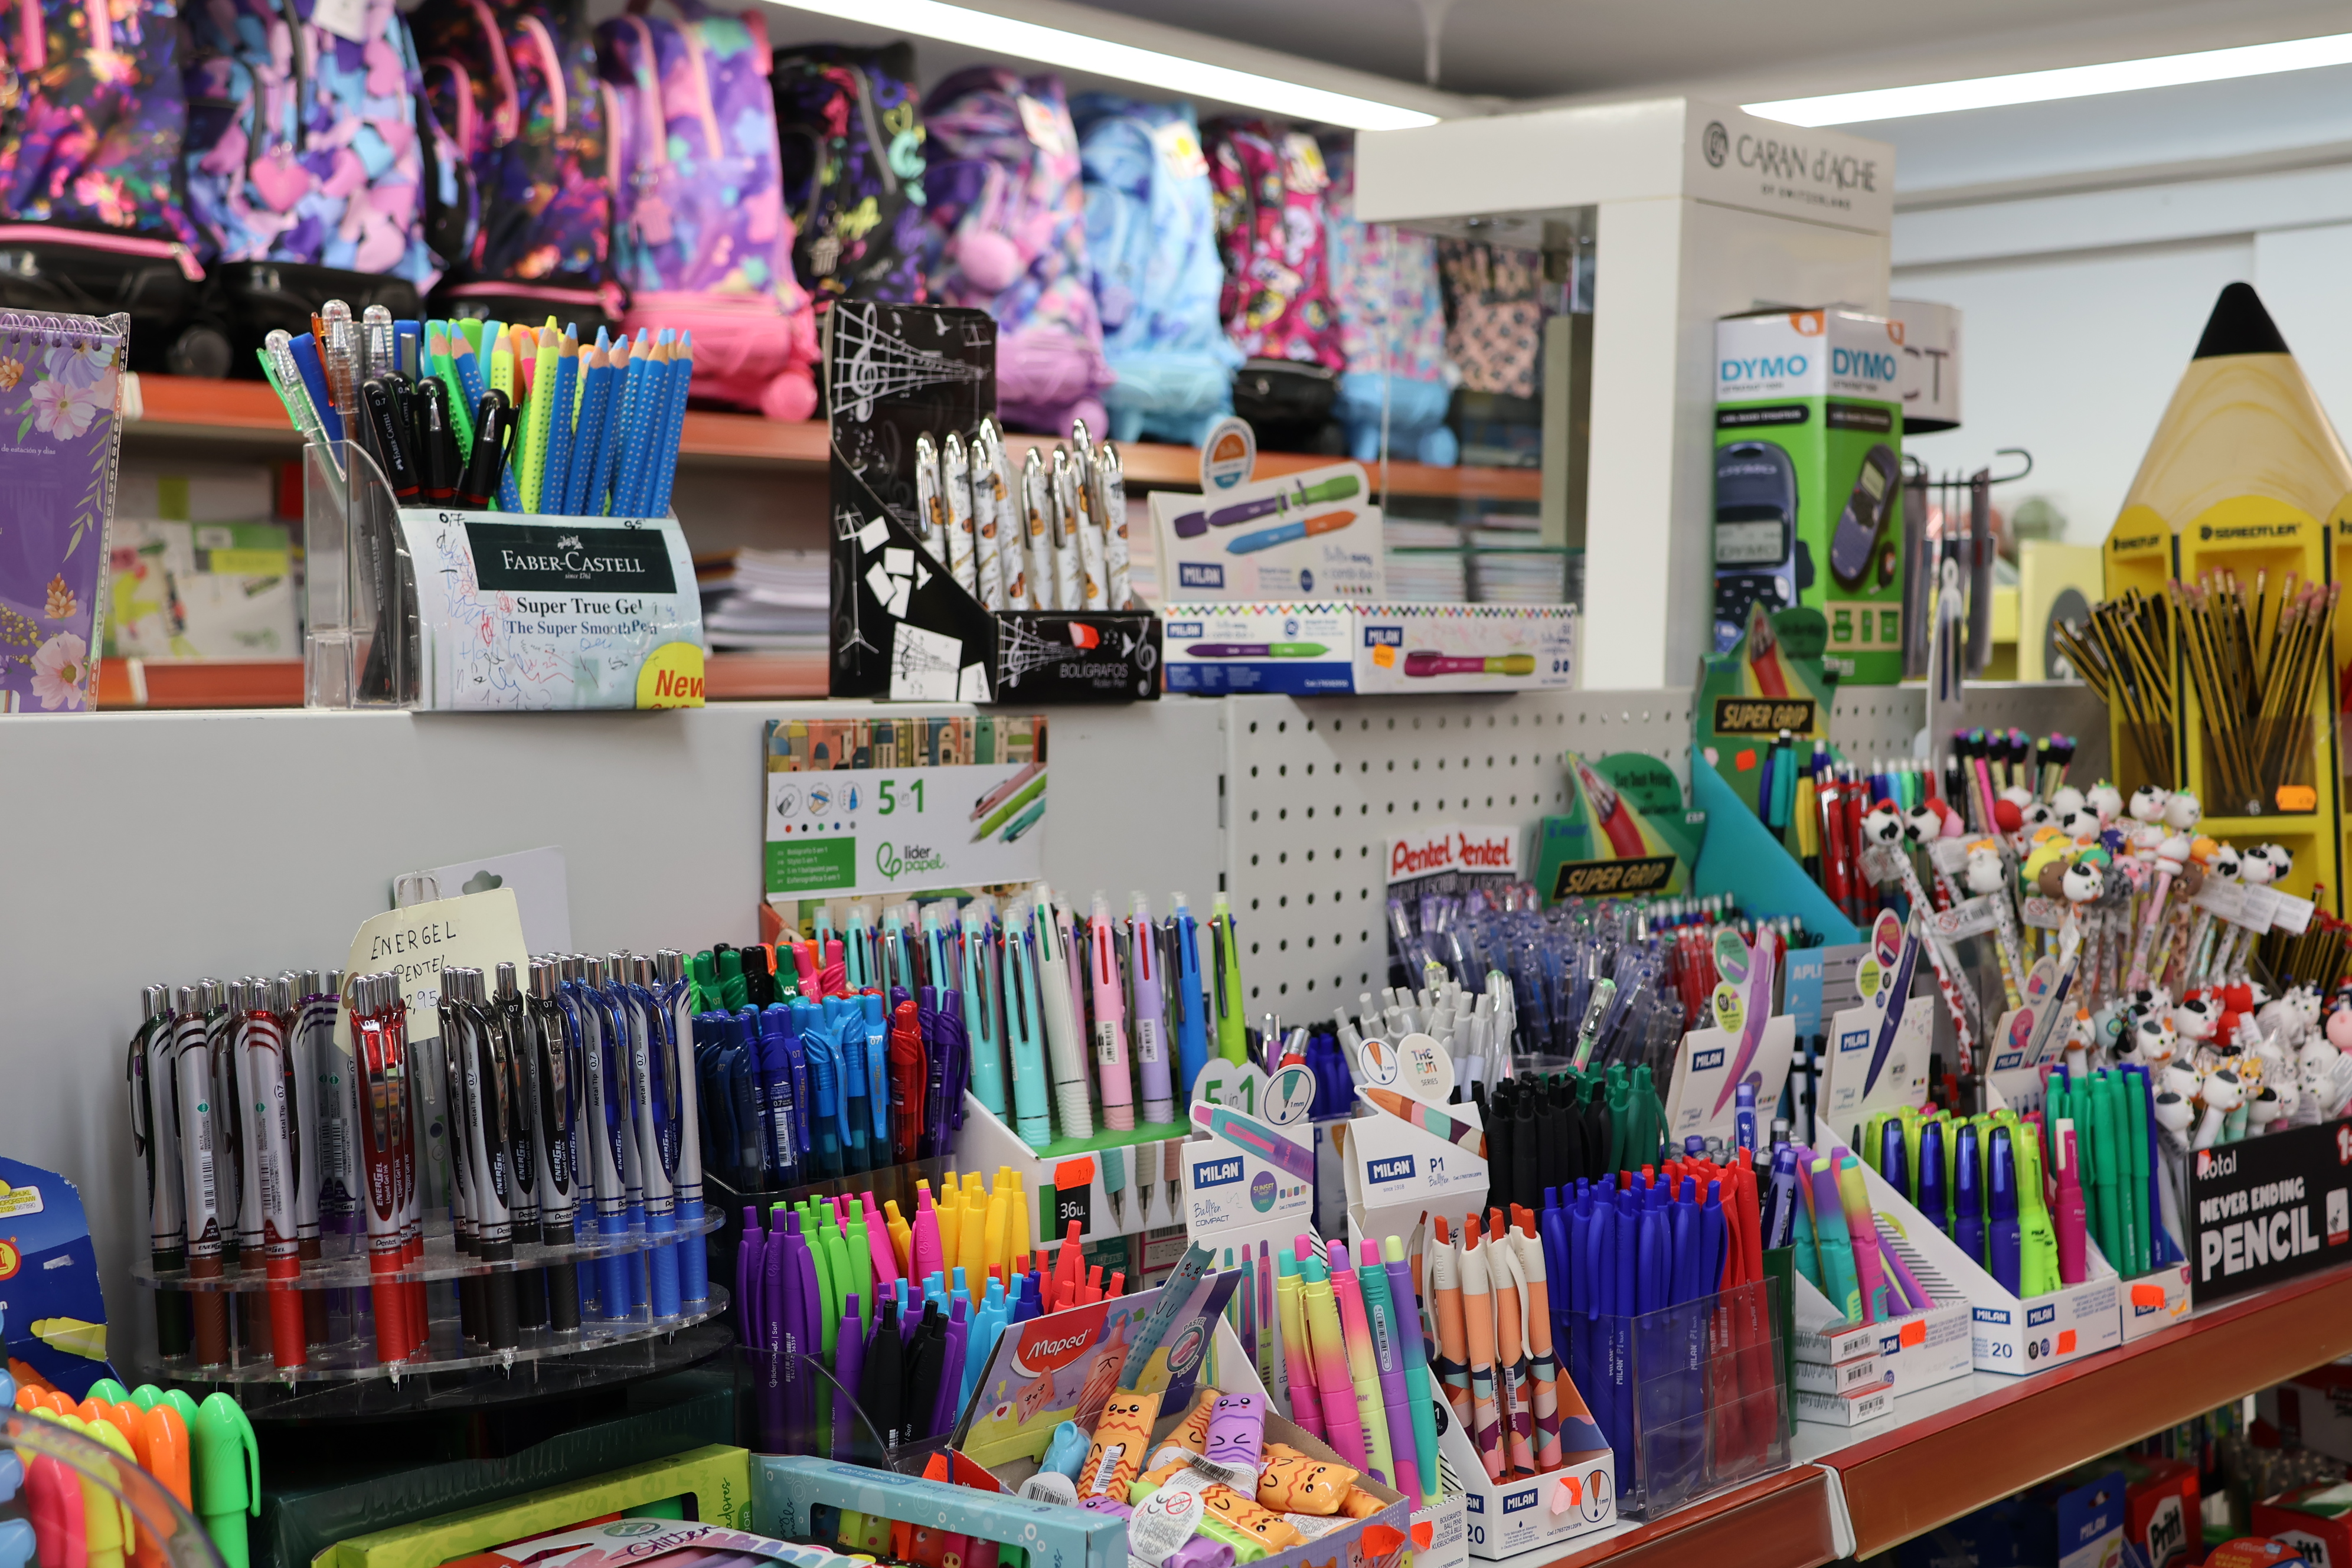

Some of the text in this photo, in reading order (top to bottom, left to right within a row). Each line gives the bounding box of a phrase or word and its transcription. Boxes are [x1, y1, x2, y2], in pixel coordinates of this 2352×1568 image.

[1737, 135, 1807, 179] CARAN
[1720, 355, 1808, 381] DYMO
[1832, 348, 1896, 381] DYMO
[375, 397, 386, 406] 0.7
[383, 413, 402, 460] FABER-CASTELL
[1, 444, 9, 452] de
[43, 446, 56, 455] días
[501, 550, 645, 573] FABER-CASTELL
[1183, 567, 1221, 584] MILAN
[517, 597, 643, 617] Super True Gel
[506, 620, 534, 634] The
[537, 620, 577, 637] Super
[581, 622, 631, 635] Smooth
[1169, 625, 1201, 636] MILAN
[1368, 629, 1400, 645] MILAN
[1059, 661, 1129, 678] BOLÍGRAFOS
[1721, 704, 1808, 730] SUPER GRIP
[878, 779, 924, 815] 5 1
[904, 845, 932, 859] lider
[1392, 831, 1511, 877] Pentel Pentel
[904, 853, 946, 874] papel
[1563, 862, 1666, 894] SUPER GRIP
[371, 922, 457, 961] ENERGEL
[394, 954, 450, 987] PENTEL
[1792, 965, 1823, 981] APLI
[406, 990, 439, 1015] 2,95
[364, 1020, 376, 1028] 07
[1843, 1034, 1868, 1049] MILAN
[1411, 1048, 1433, 1061] THE
[1696, 1052, 1722, 1069] MILAN
[1995, 1055, 2021, 1070] MILAN
[1421, 1078, 1439, 1086] SERIES
[517, 1138, 525, 1181] ENERGEL
[553, 1139, 562, 1182] ENERGEL
[1283, 1145, 1292, 1167] MILAN
[494, 1151, 503, 1194] ENERGEL
[1200, 1161, 1239, 1184] MILAN
[1373, 1161, 1410, 1180] MILAN
[1429, 1157, 1445, 1173] P1
[373, 1162, 383, 1207] ENERGEL
[1253, 1182, 1275, 1194] SUNSET
[2199, 1175, 2305, 1225] NEVER ENDING
[554, 1212, 573, 1221] Pentel
[1060, 1201, 1086, 1220] 36u.
[1196, 1214, 1229, 1227] COMPACT
[2200, 1205, 2320, 1283] PENCIL
[1977, 1310, 2007, 1322] MILAN
[2030, 1307, 2053, 1324] MILAN
[1182, 1317, 1206, 1332] PASTEL
[1025, 1328, 1088, 1361] Maped
[1992, 1342, 2013, 1358] 20
[866, 1472, 907, 1484] COLORES
[1033, 1482, 1049, 1492] 436059
[1507, 1492, 1535, 1510] MILAN
[1599, 1497, 1609, 1505] 1mm
[1439, 1510, 1462, 1524] BOLÍGRAFOS
[1453, 1518, 1462, 1527] PENS
[1436, 1525, 1462, 1541] STYLOS BILLE
[1468, 1523, 1485, 1545] 20
[1547, 1522, 1582, 1537] Cod.1765729120FN
[2079, 1514, 2108, 1541] MILAN
[2151, 1505, 2181, 1559] Pritt
[1432, 1533, 1463, 1550] KUGELSCHREIBER
[1504, 1541, 1520, 1550] Deutschland
